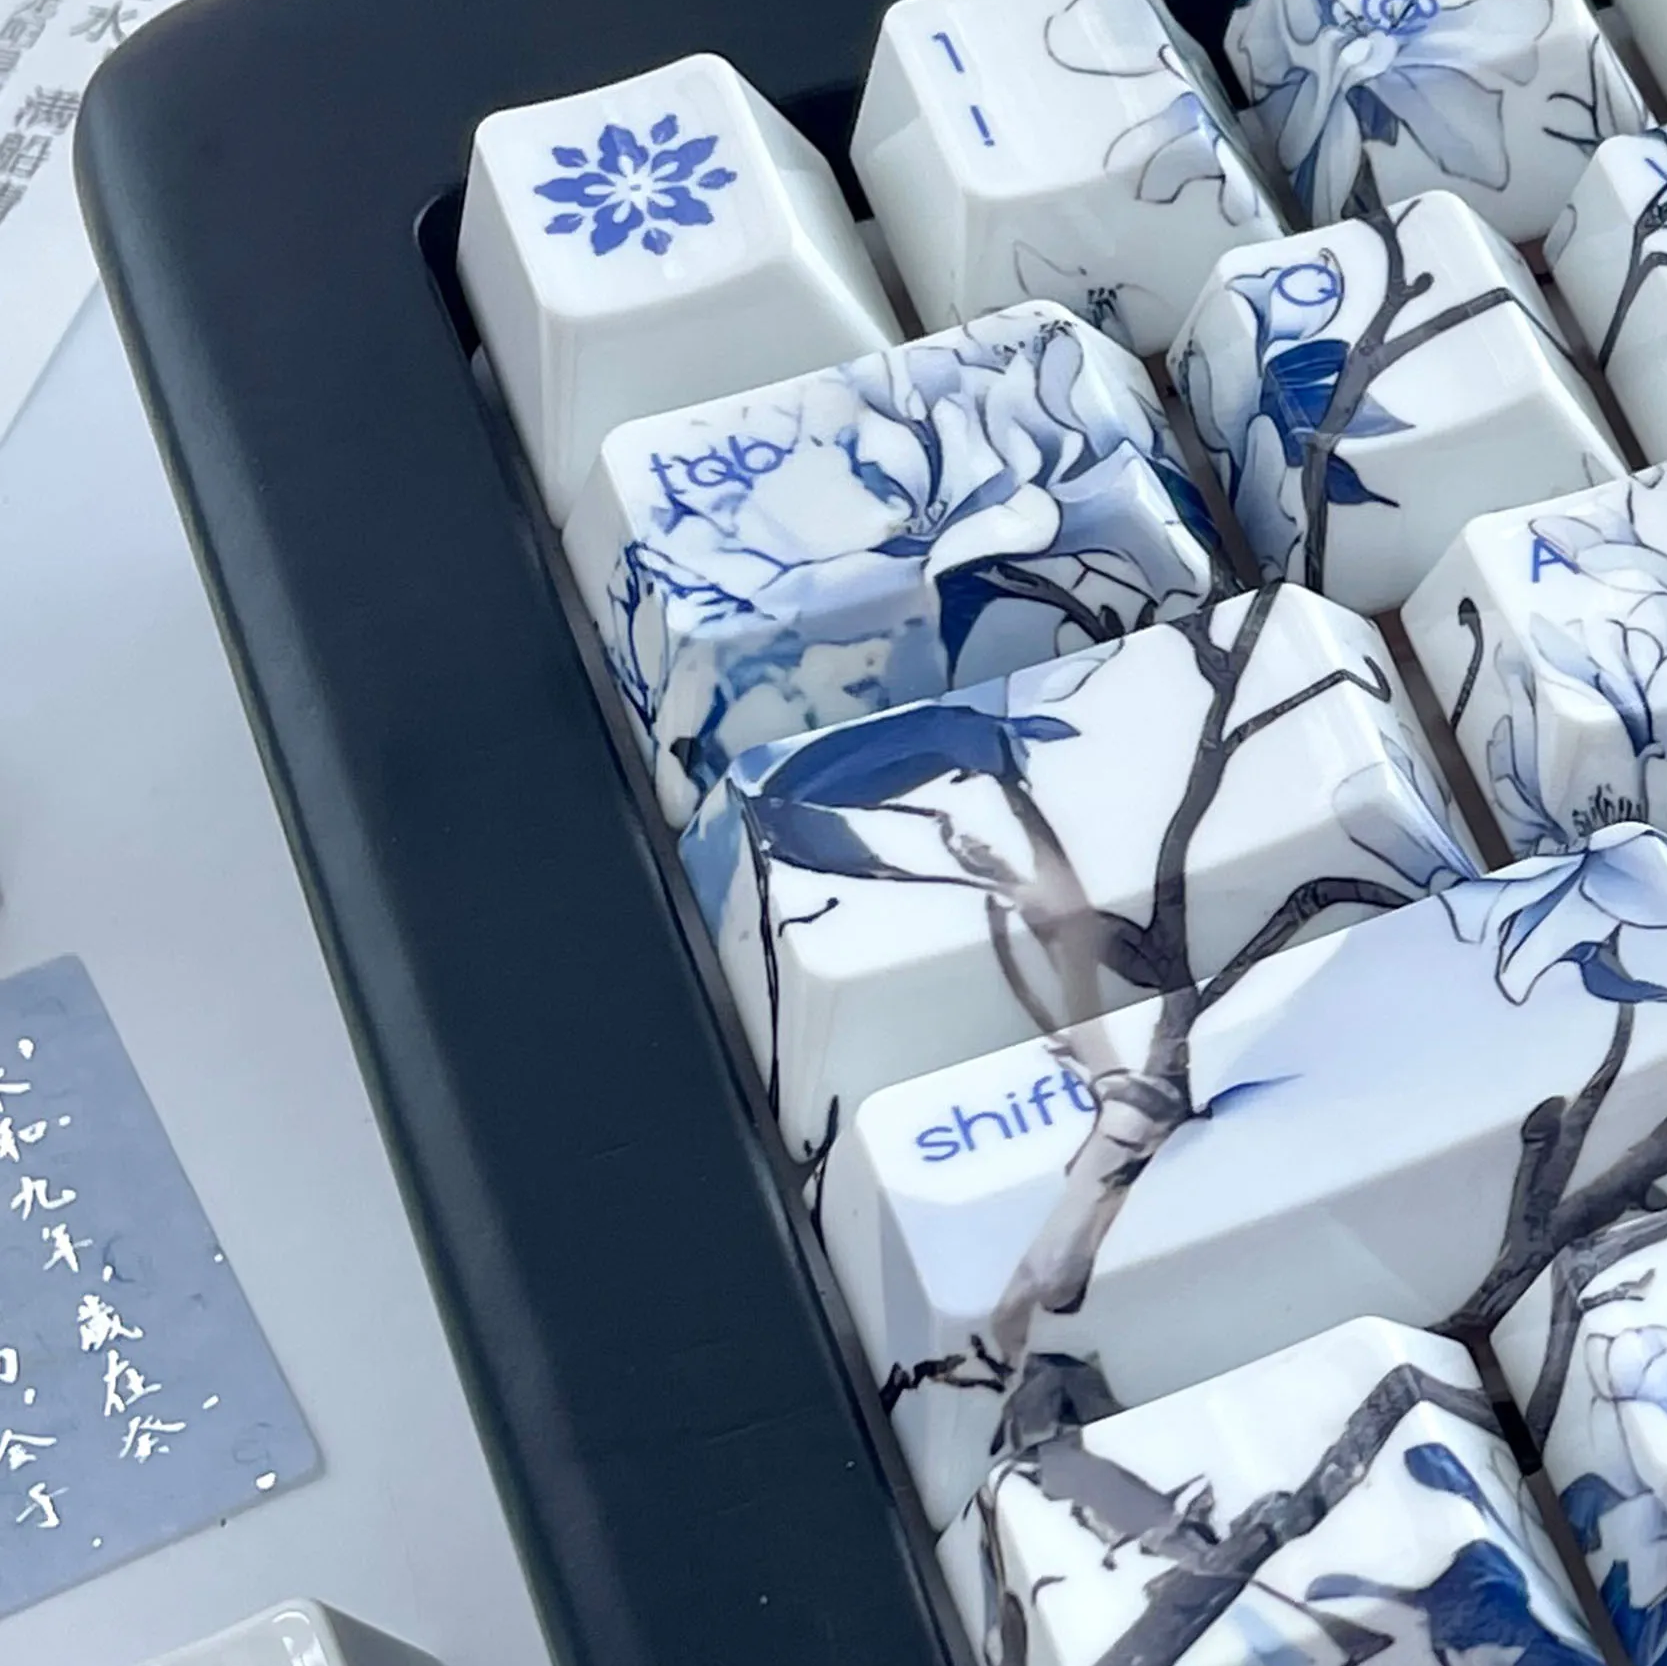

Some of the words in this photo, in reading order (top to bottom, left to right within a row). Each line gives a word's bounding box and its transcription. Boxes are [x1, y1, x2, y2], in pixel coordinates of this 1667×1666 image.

[932, 32, 965, 73] 1
[1276, 263, 1339, 307] Q
[1532, 536, 1580, 583] A
[914, 1068, 1094, 1165] shift
[0, 1068, 187, 1464] 和九年，歲在癸
